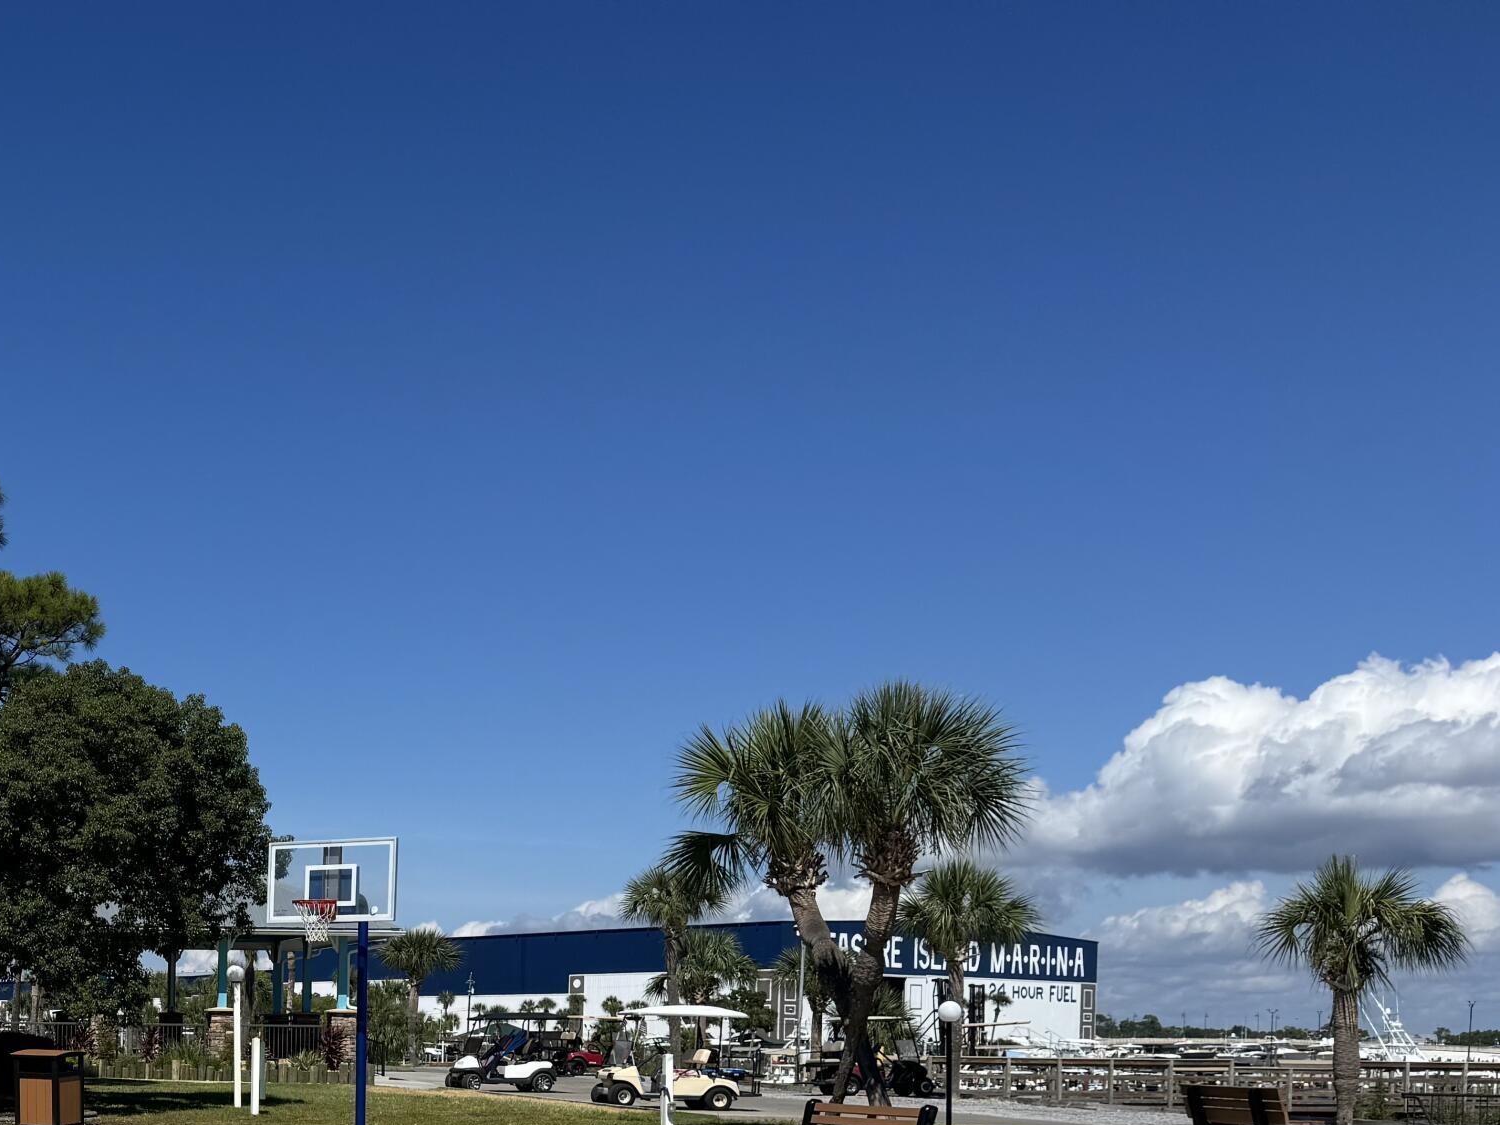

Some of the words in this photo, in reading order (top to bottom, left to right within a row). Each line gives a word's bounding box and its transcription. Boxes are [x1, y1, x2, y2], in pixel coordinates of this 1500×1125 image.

[913, 937, 980, 972] ISLD
[989, 983, 1006, 1000] 24
[1012, 985, 1044, 1000] HOUR
[1049, 985, 1077, 1003] FUEL
